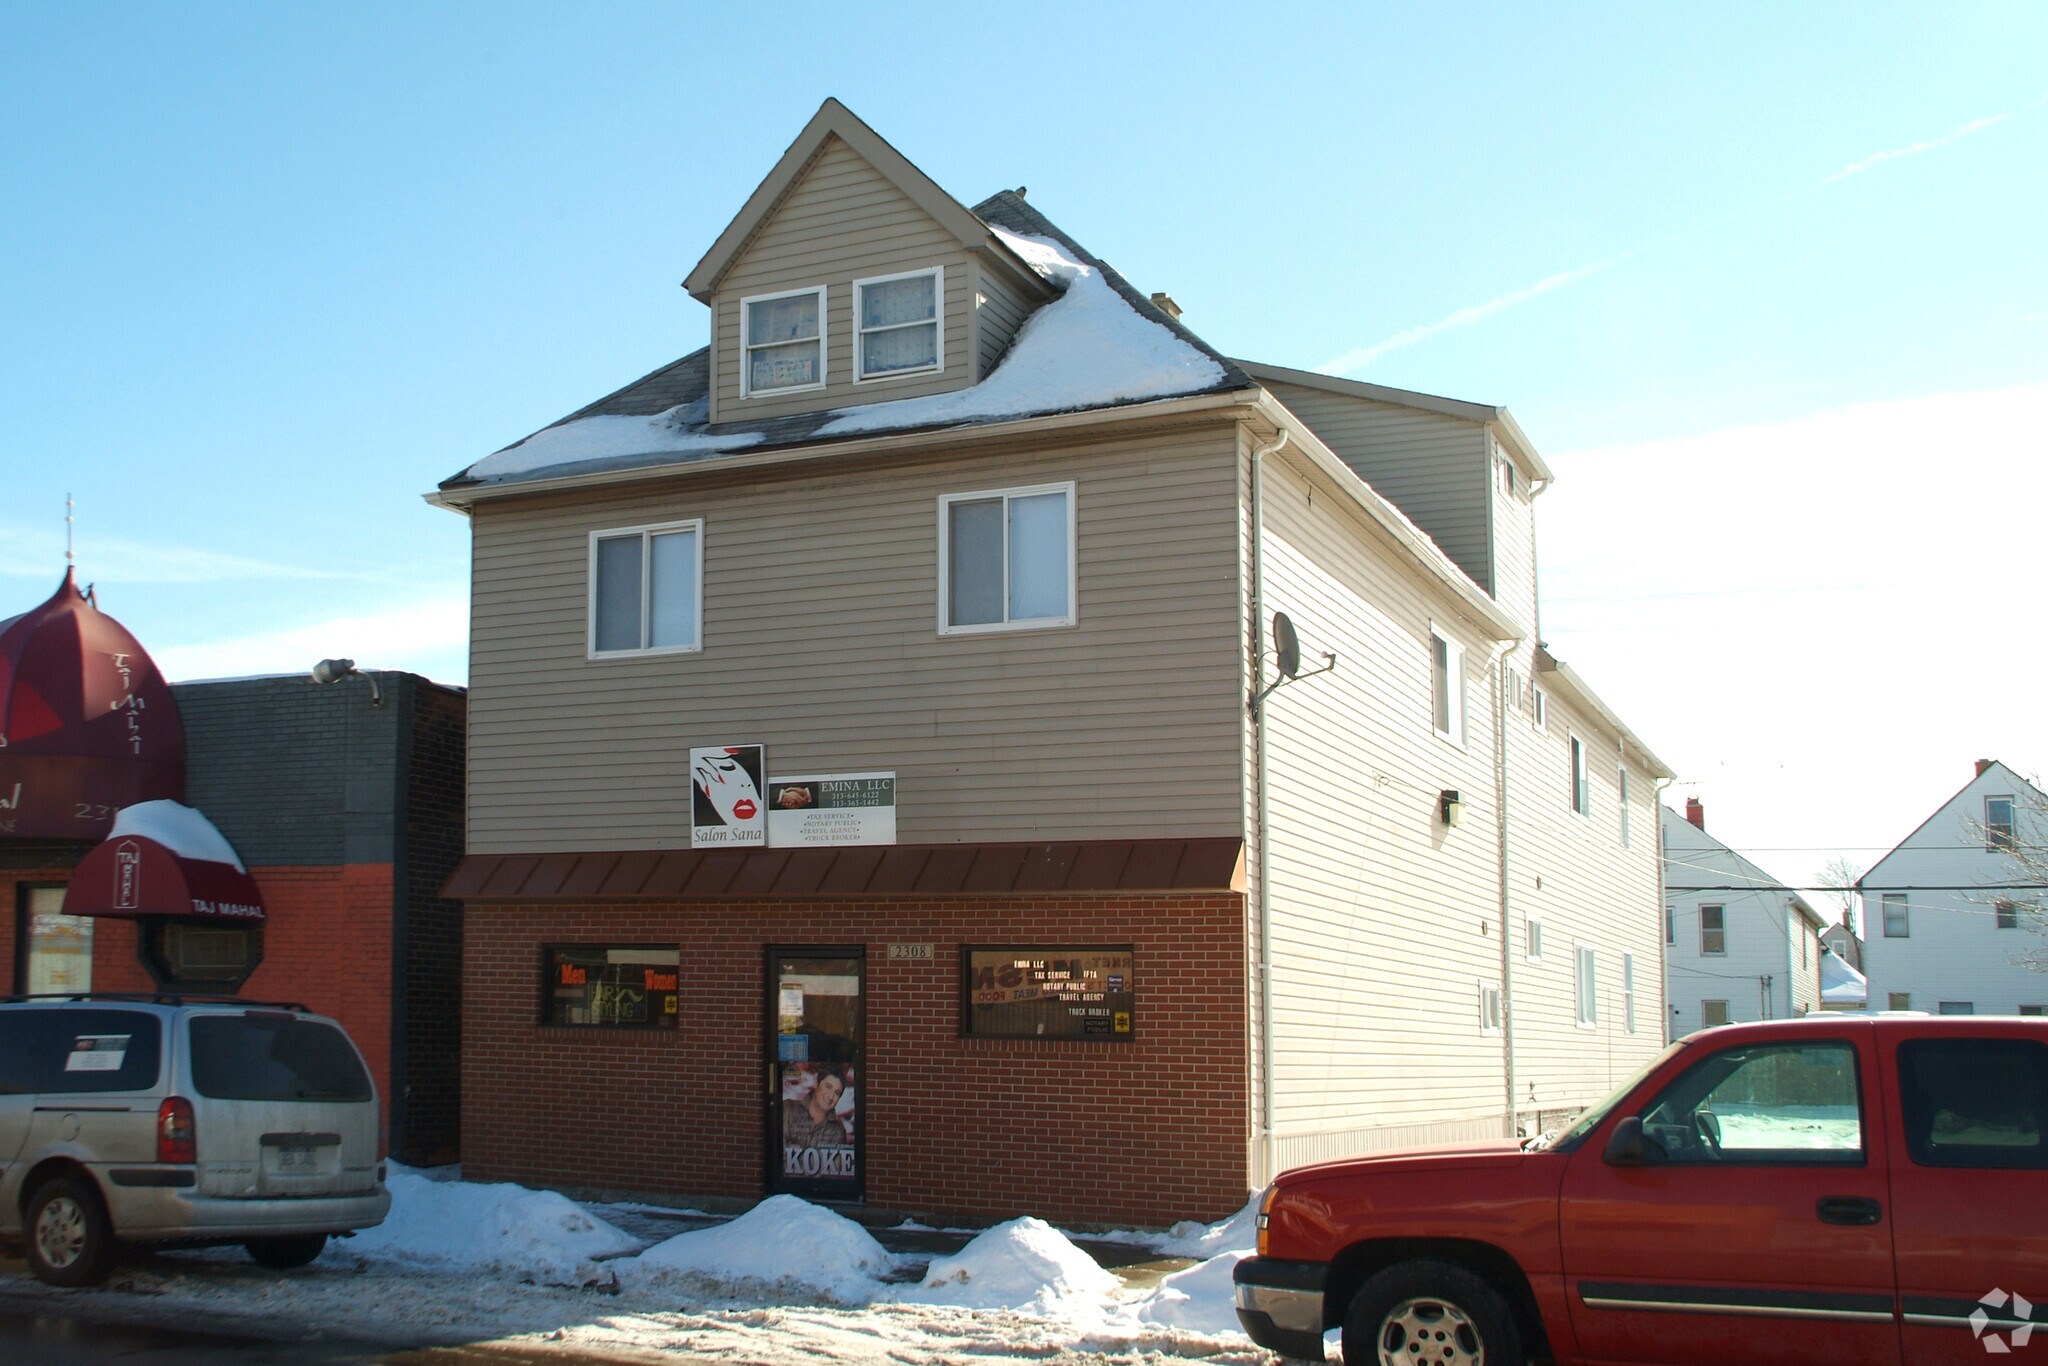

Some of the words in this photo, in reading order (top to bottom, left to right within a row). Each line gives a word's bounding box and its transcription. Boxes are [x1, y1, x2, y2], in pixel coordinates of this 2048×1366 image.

[821, 781, 860, 793] EMINA
[867, 779, 891, 791] LLC
[694, 826, 728, 843] Salon
[731, 827, 763, 842] Sana
[117, 851, 140, 864] TAJ
[192, 899, 217, 914] TAJ
[218, 902, 266, 918] MAHAL
[895, 946, 927, 958] 2308
[1033, 960, 1045, 968] LLC
[561, 964, 586, 984] Men
[645, 969, 678, 990] Women
[1034, 971, 1046, 980] TAX
[1047, 971, 1071, 979] SERVICE
[1042, 982, 1065, 991] NOTARY
[1066, 982, 1086, 990] PUBLIC
[1059, 993, 1080, 1001] TRAVEL
[1082, 993, 1105, 1001] AGENCY
[1068, 1008, 1086, 1016] TRUCK
[1088, 1008, 1111, 1016] BROKER
[785, 1147, 855, 1177] KOKE
